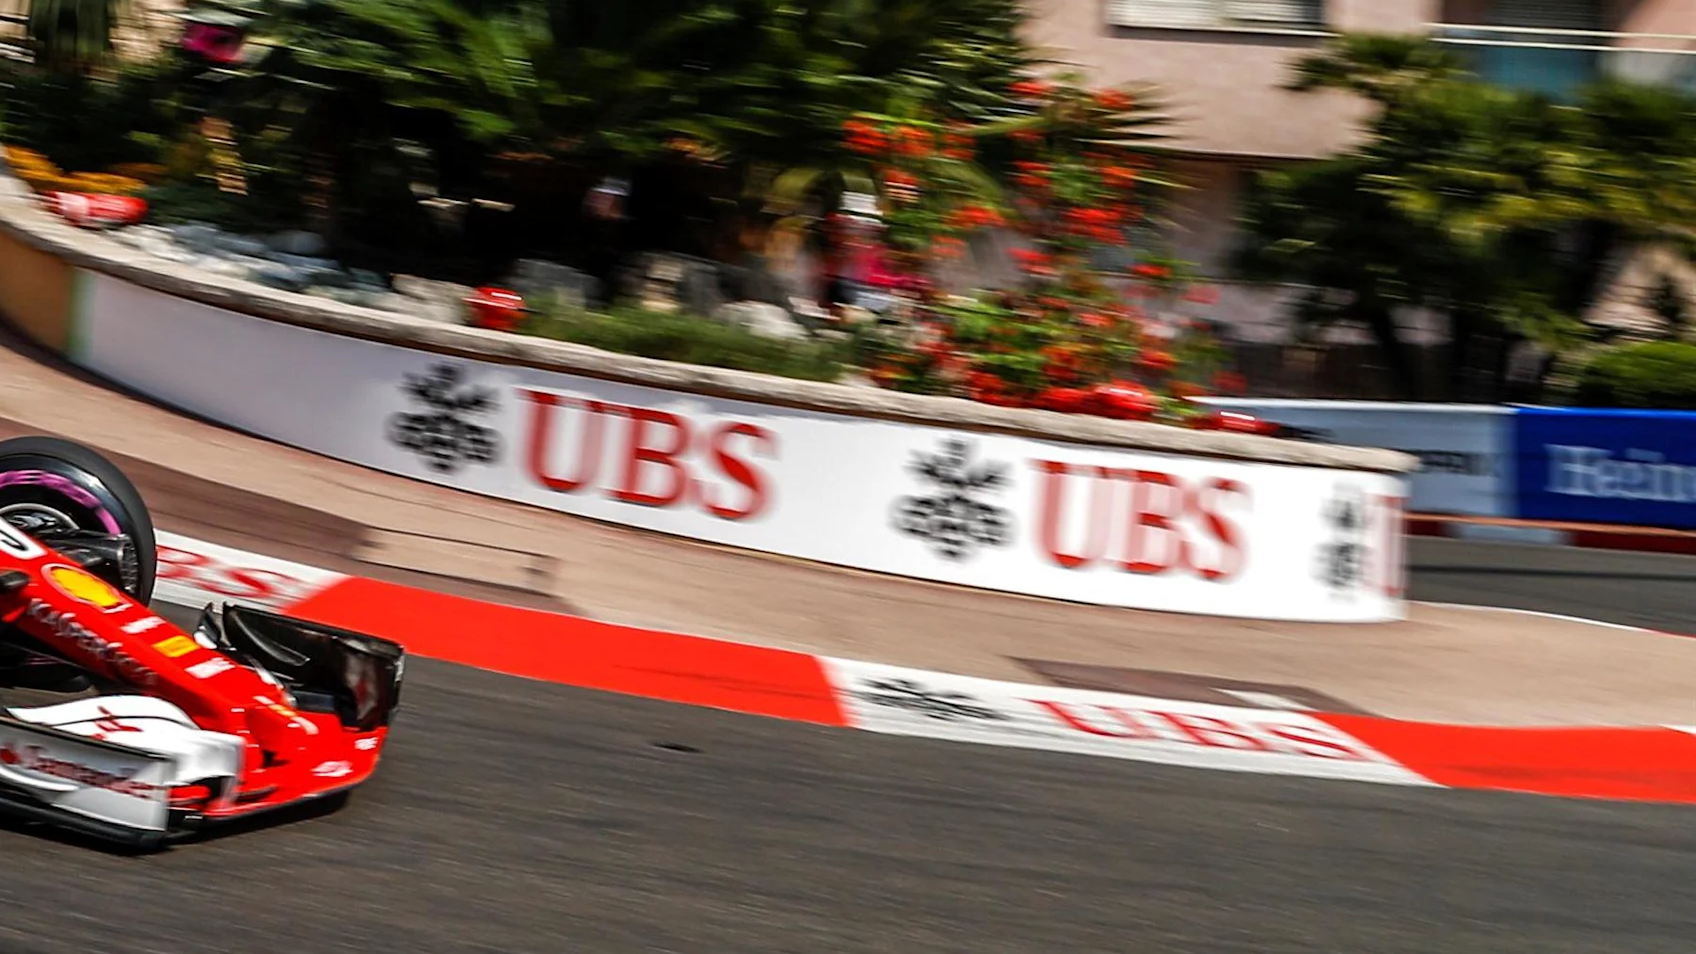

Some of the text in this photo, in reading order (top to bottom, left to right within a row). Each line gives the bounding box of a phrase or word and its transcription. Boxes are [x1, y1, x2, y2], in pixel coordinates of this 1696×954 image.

[514, 387, 781, 520] UBS
[1027, 458, 1252, 581] UBS
[1014, 697, 1376, 760] UBS
